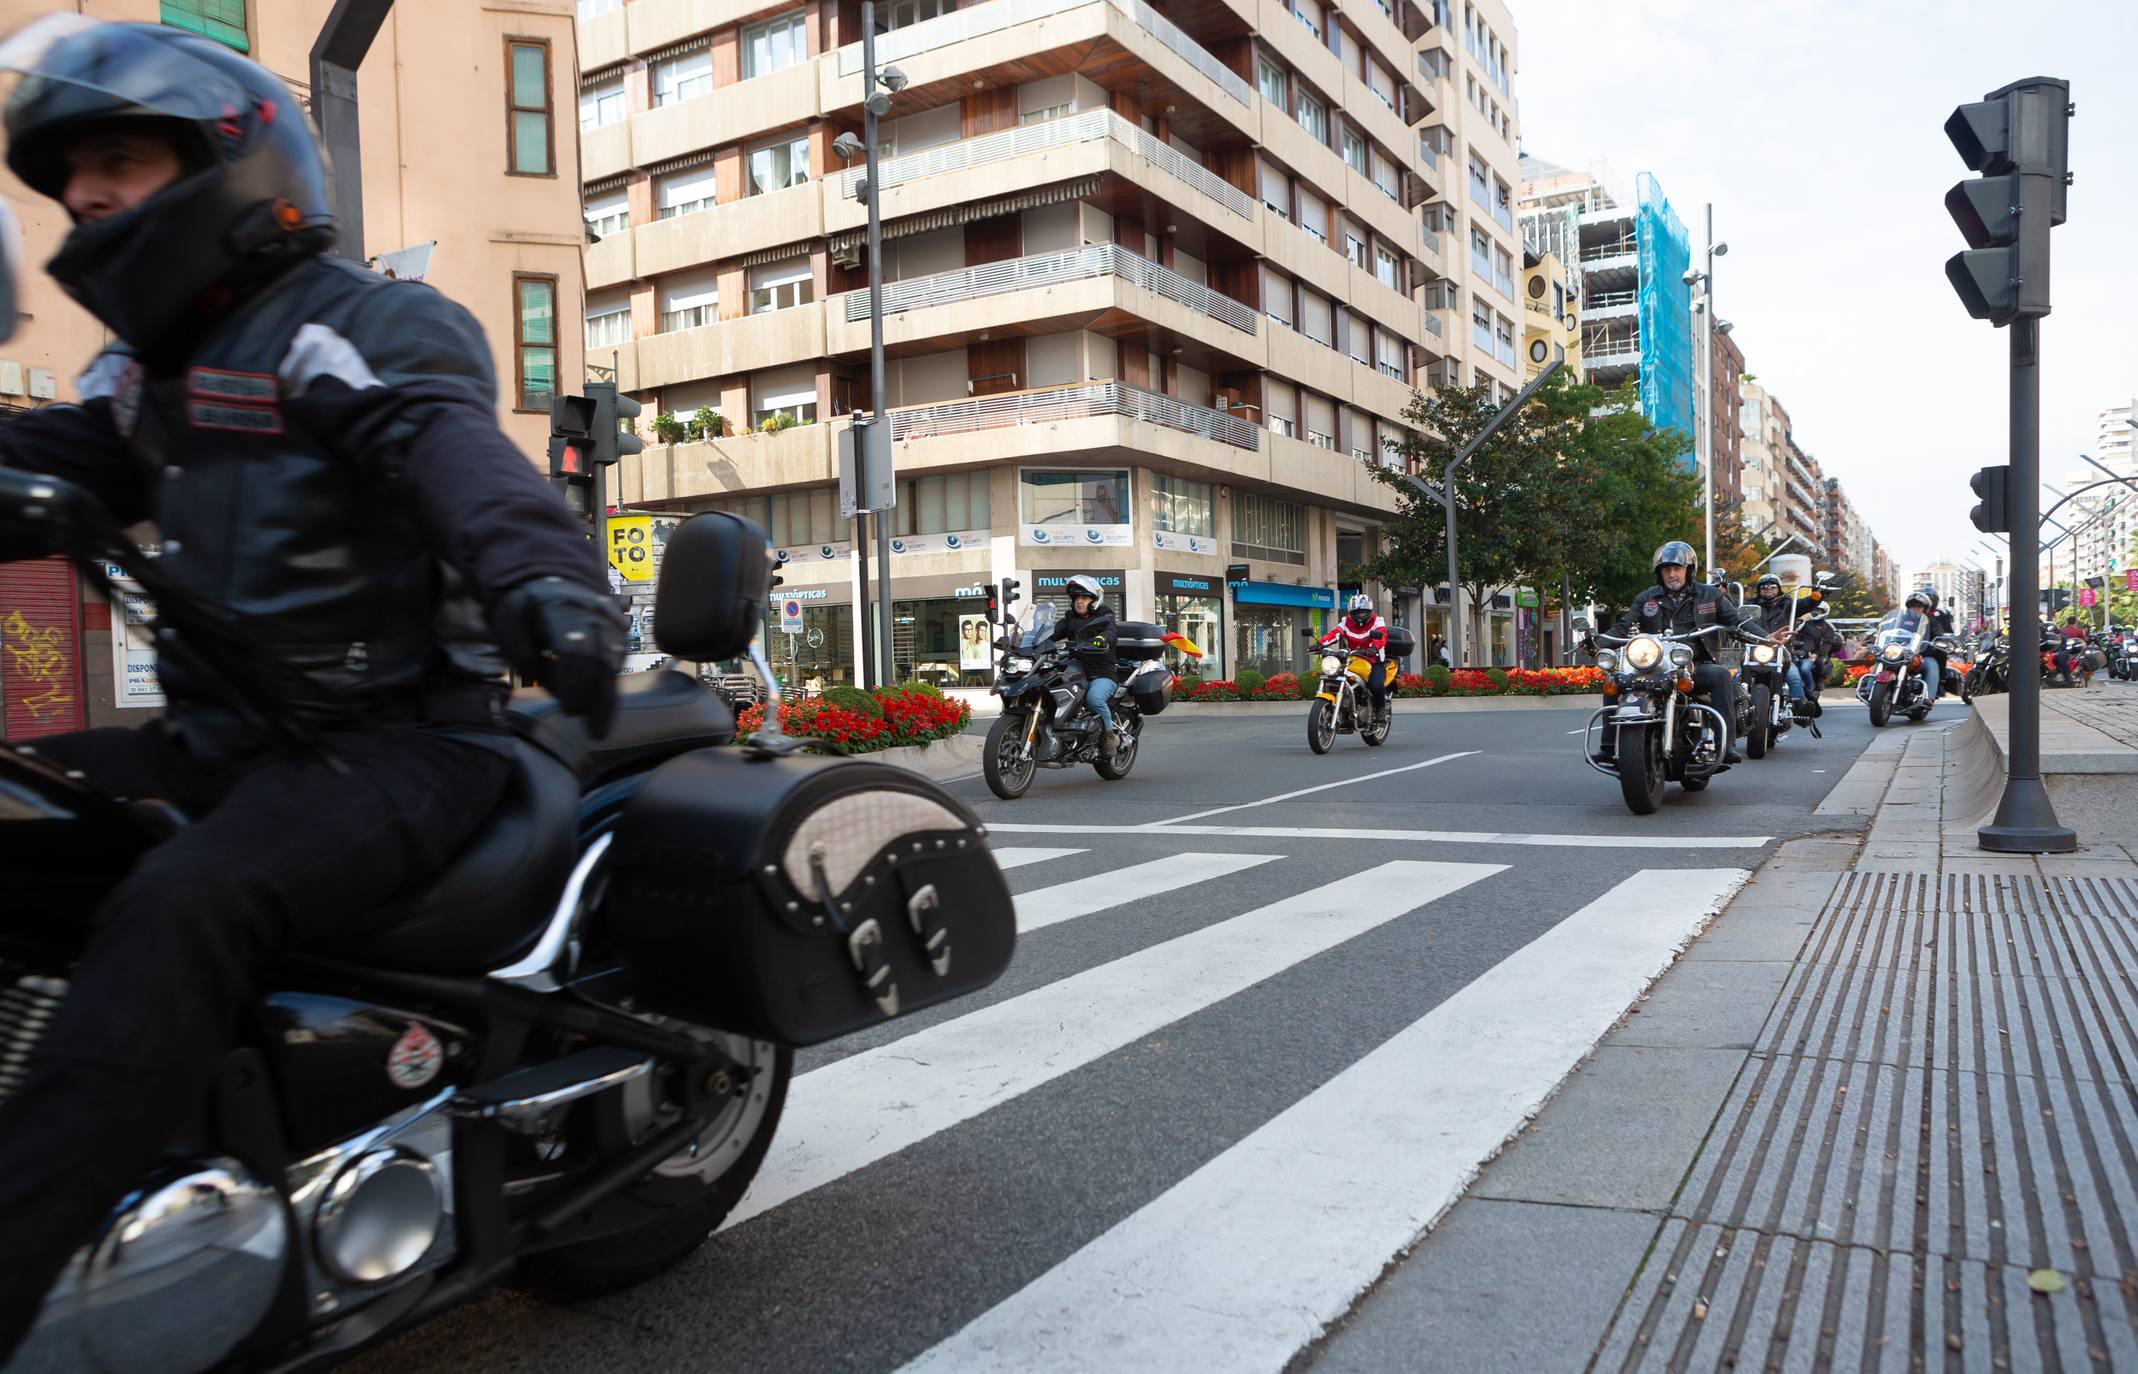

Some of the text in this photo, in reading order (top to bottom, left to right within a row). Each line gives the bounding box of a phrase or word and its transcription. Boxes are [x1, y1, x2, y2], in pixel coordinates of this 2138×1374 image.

[613, 527, 645, 545] FO
[613, 546, 646, 564] TO
[1038, 576, 1120, 587] multicas
